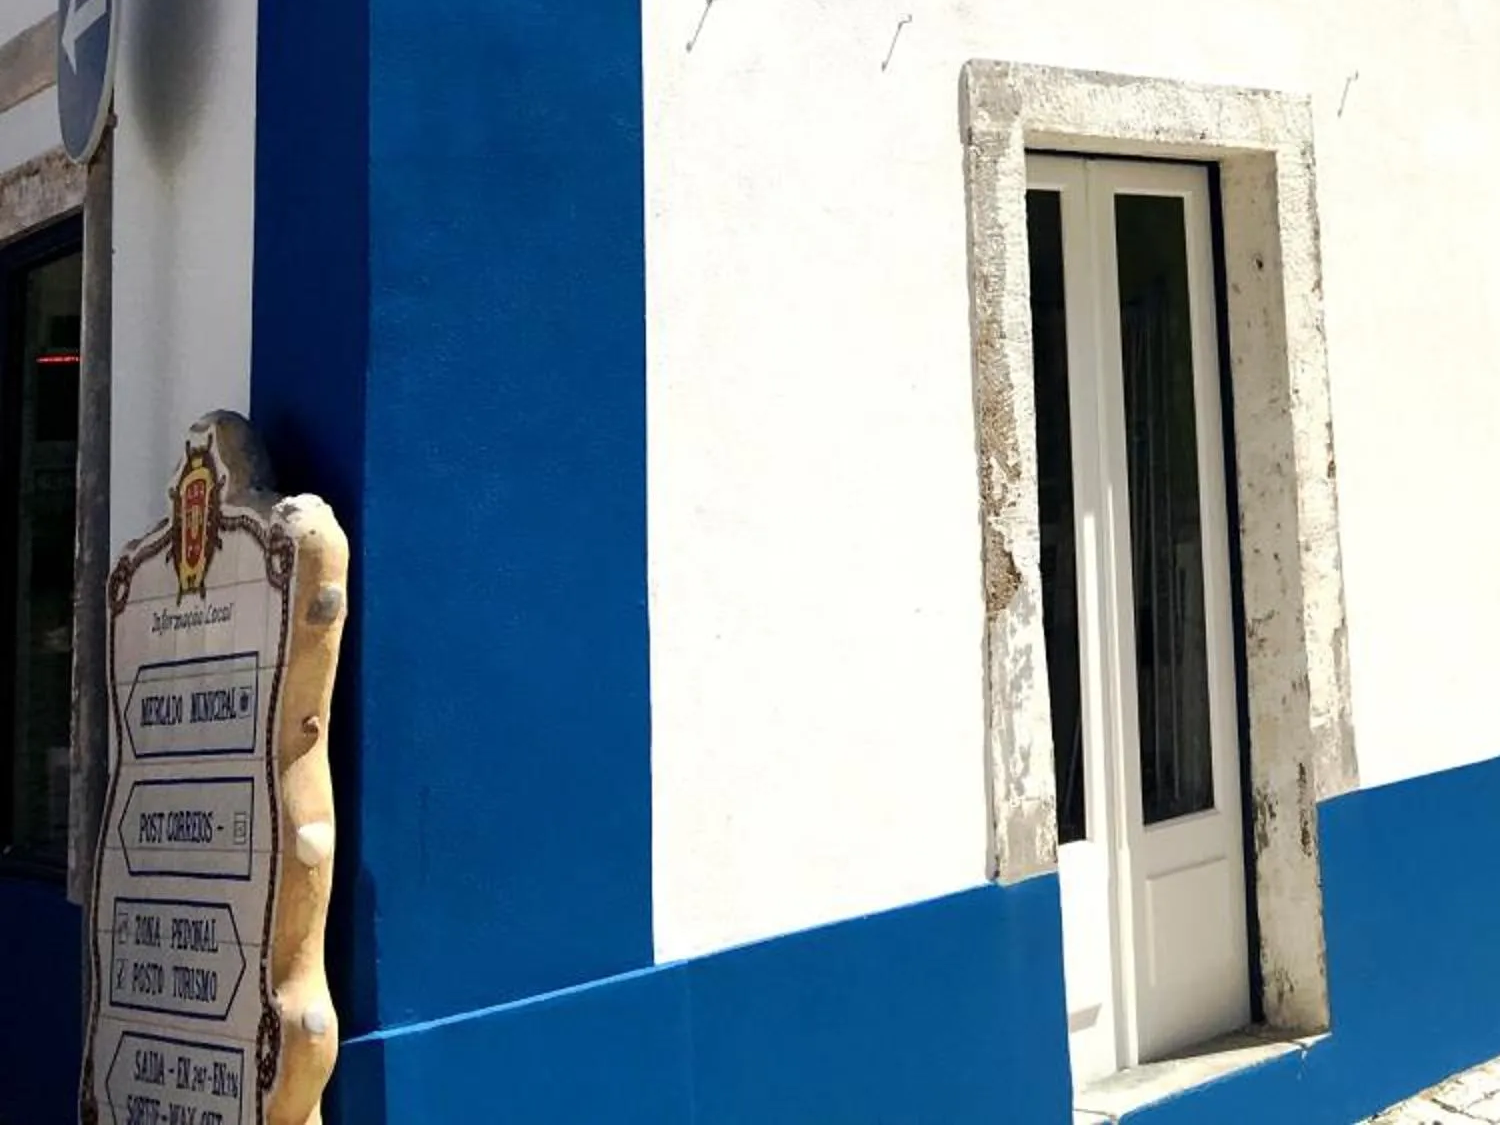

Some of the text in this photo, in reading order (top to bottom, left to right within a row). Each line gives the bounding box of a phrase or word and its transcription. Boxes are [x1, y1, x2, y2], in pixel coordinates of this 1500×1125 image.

[203, 602, 234, 625] Local
[141, 686, 237, 728] MERCADO MUNICIPAL
[166, 810, 214, 843] CORREIOS
[135, 914, 218, 953] ZONA PEDONAL
[132, 961, 216, 1003] POSTO TURISMO
